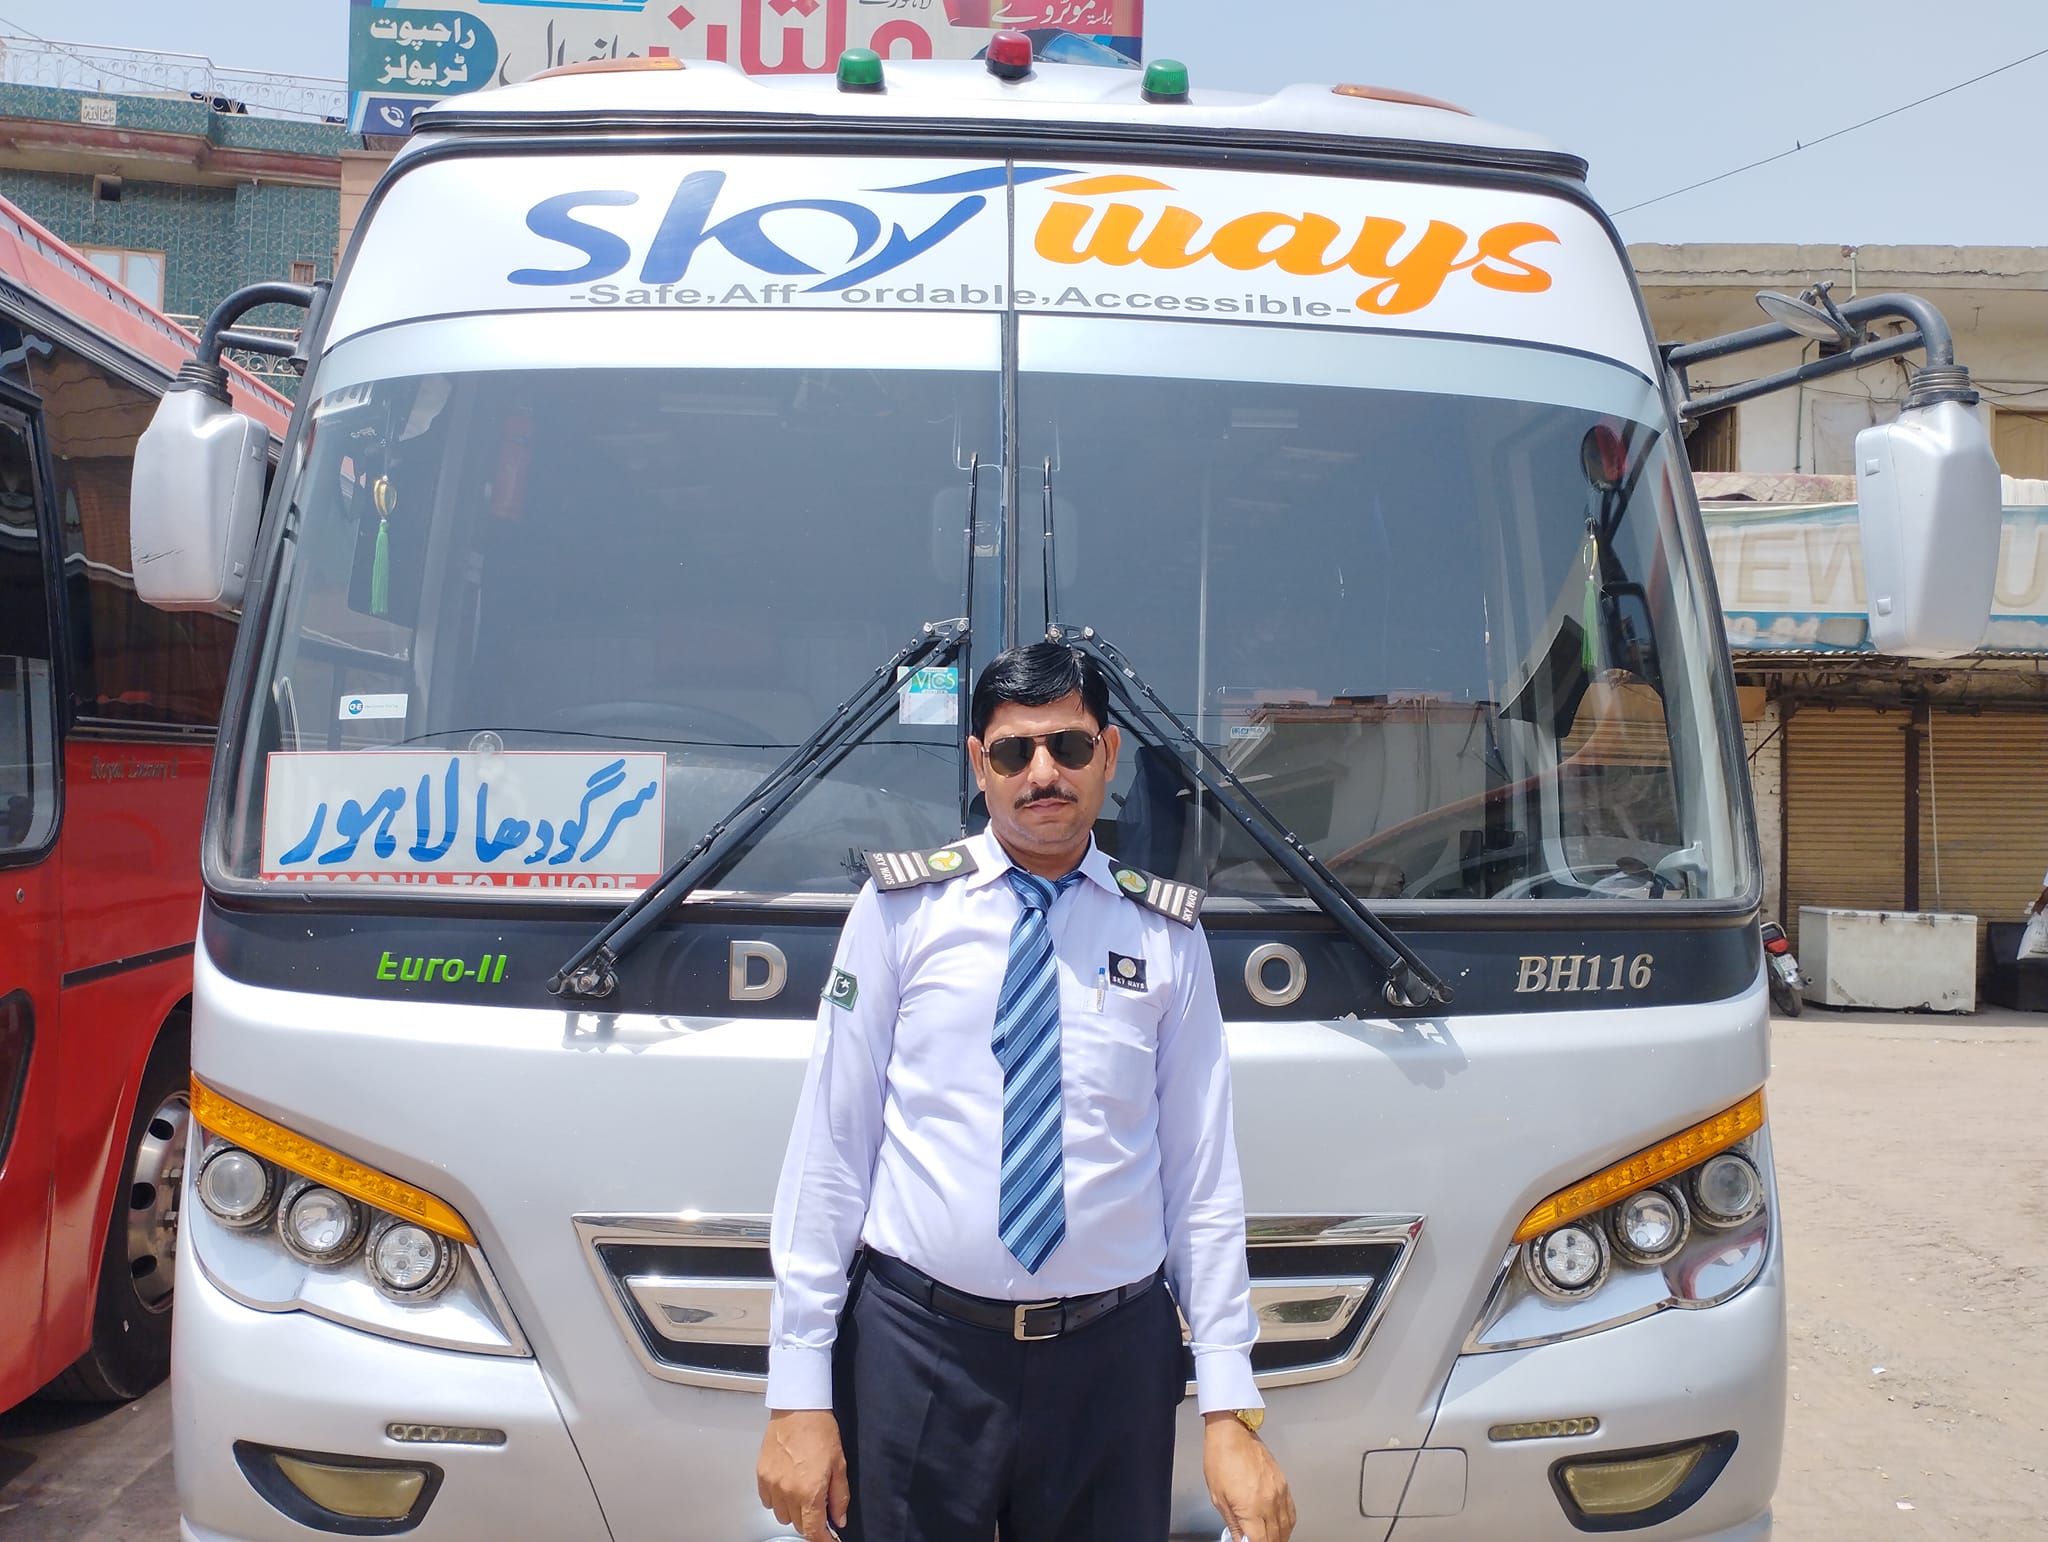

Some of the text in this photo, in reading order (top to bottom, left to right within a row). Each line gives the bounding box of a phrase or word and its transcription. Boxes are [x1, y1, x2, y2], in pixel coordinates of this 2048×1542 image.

[370, 17, 476, 52] راجپوت
[376, 52, 468, 87] ٹریولز
[278, 756, 658, 866] سرگودھا لاہور
[872, 853, 896, 885] SKY WAYS
[1182, 888, 1198, 922] SKY WAYS
[376, 951, 508, 983] Euro-II
[729, 940, 1308, 1007] D O
[1112, 976, 1126, 985] SKY
[1514, 953, 1654, 993] BH116
